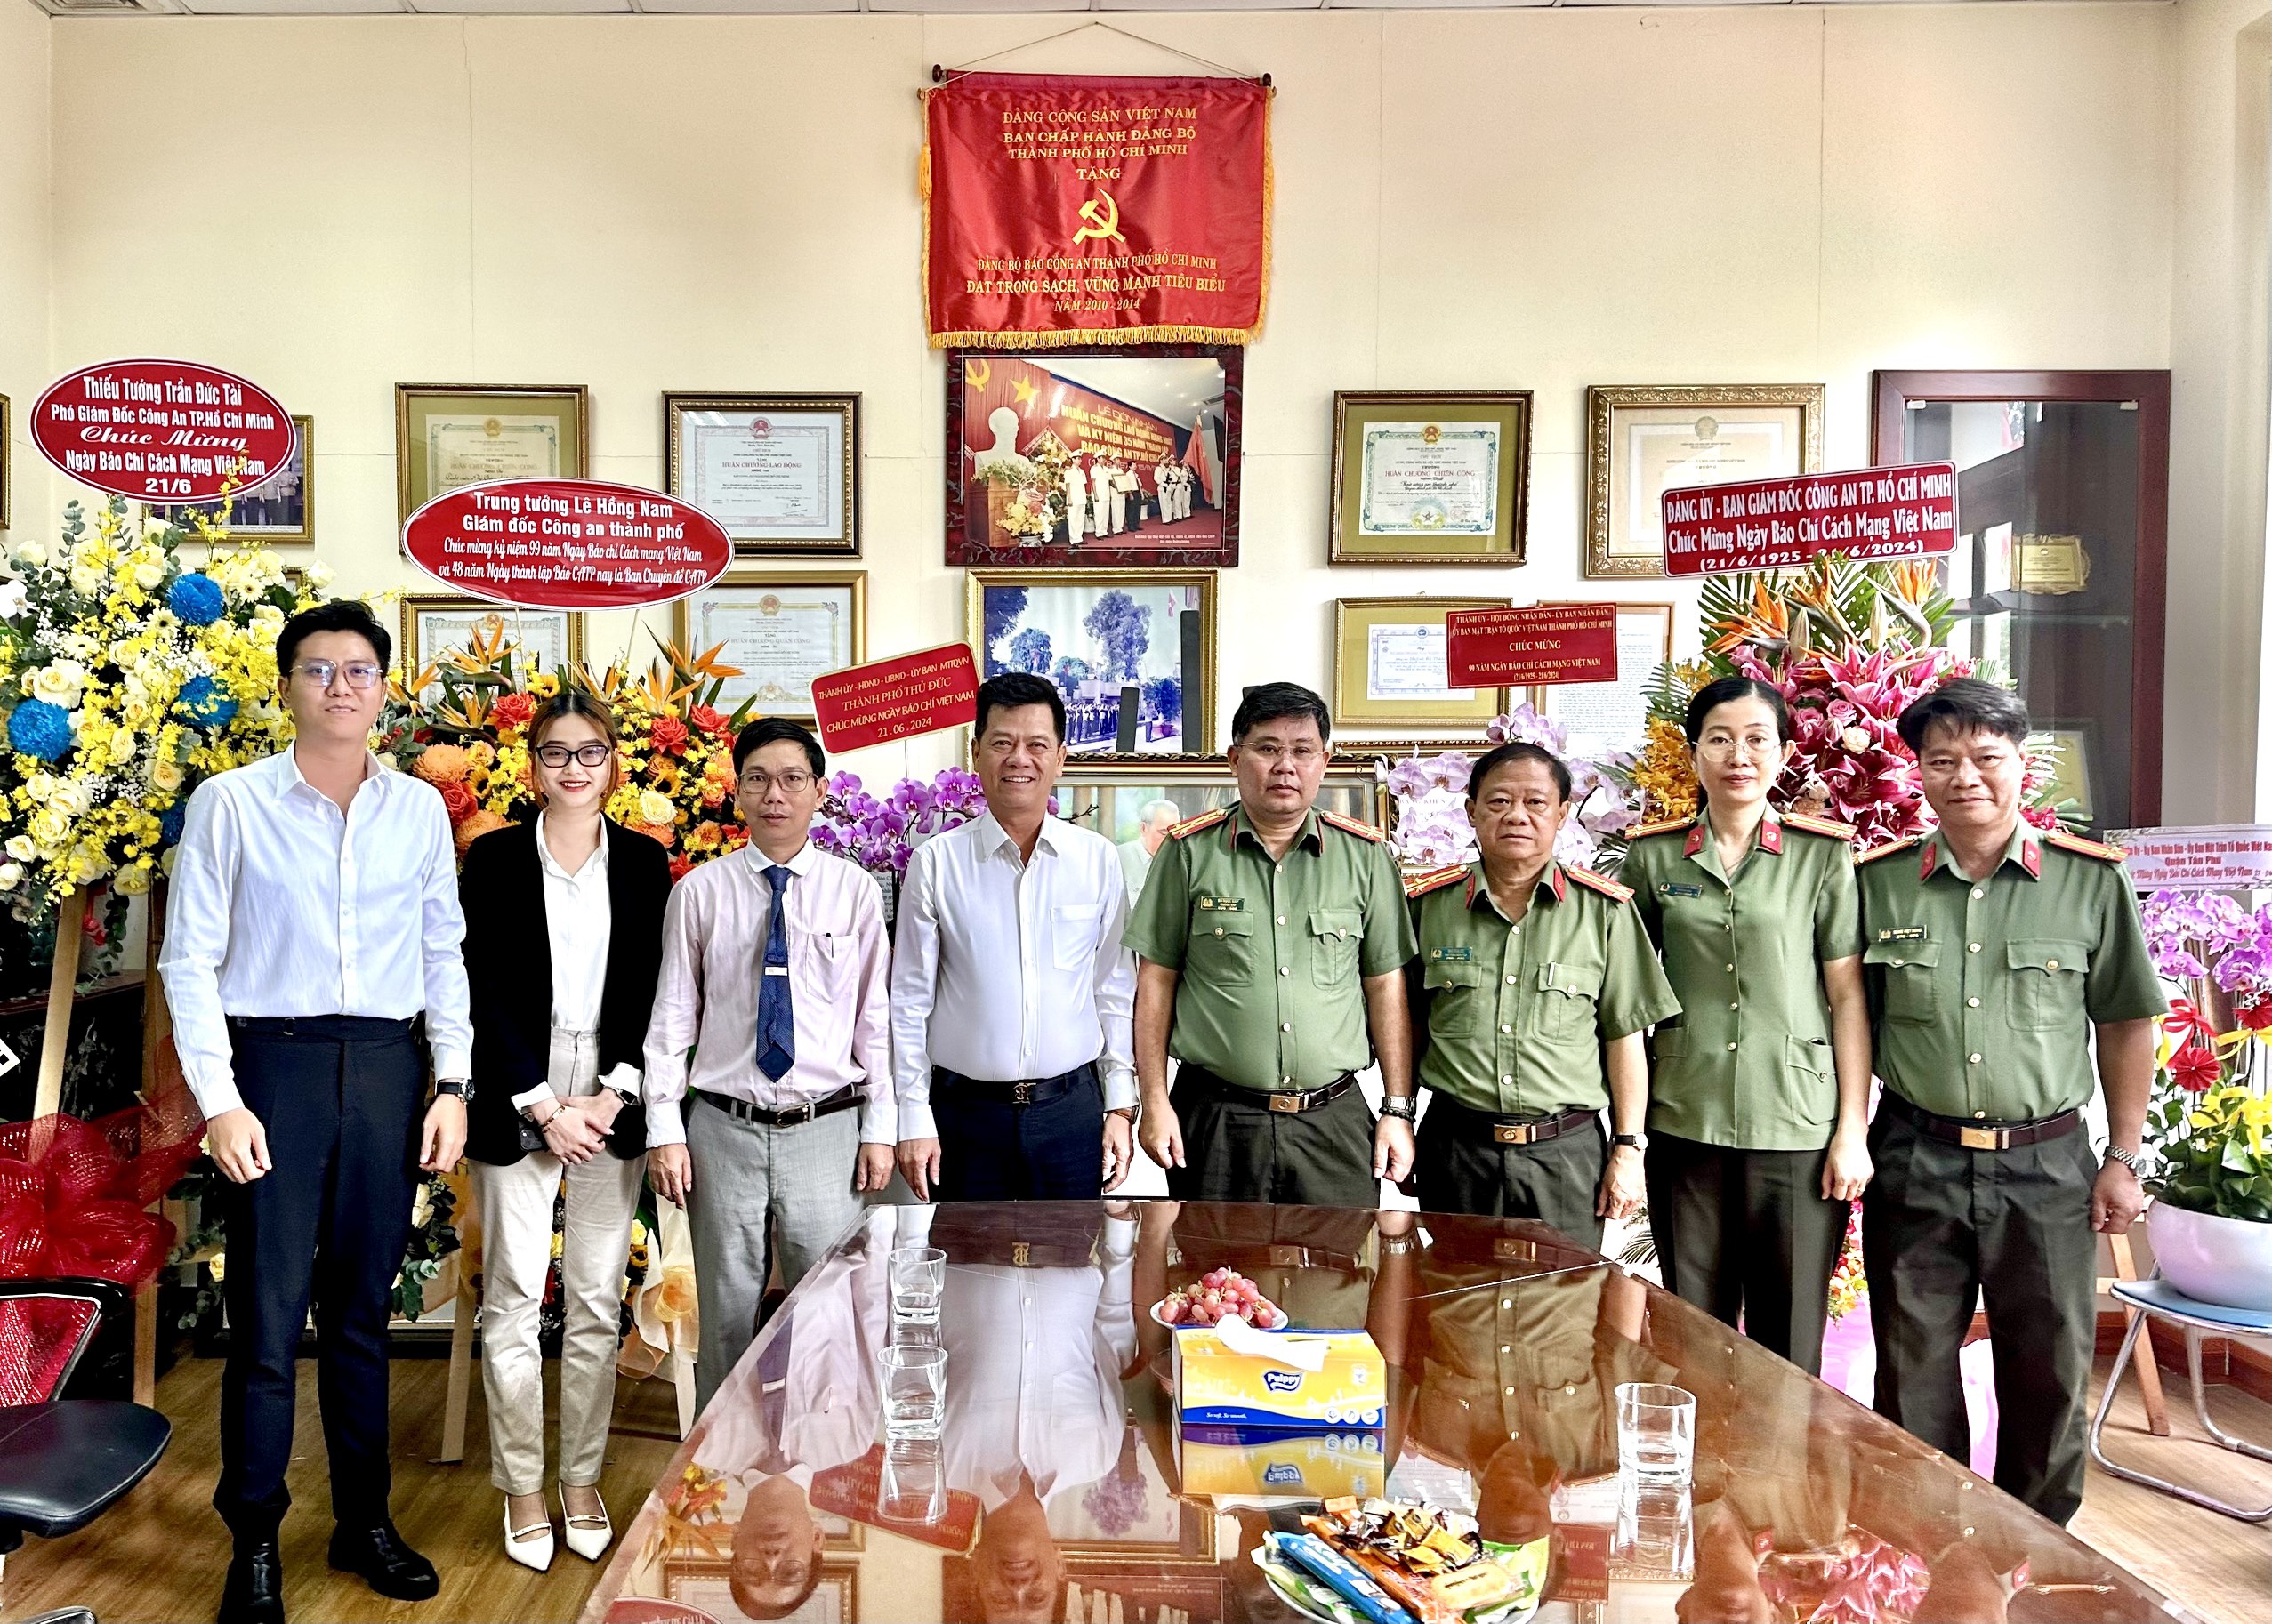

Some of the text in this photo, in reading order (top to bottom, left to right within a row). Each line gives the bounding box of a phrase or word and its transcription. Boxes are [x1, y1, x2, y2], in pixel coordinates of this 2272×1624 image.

[1003, 106, 1196, 125] ĐẢNG CỘNG SẢN VIỆT NAM
[1003, 125, 1196, 143] BAN CHẤP HÀNH ĐẢNG BỘ
[1009, 143, 1187, 159] THÀNH PHỐ HỒ CHÍ MINH
[1076, 165, 1122, 182] TẶNG
[978, 255, 1005, 271] ĐẢNG
[1008, 257, 1021, 273] BỘ
[1024, 255, 1044, 270] BÁO
[1076, 257, 1091, 269] AN
[1092, 254, 1129, 269] THÀNH
[1132, 248, 1152, 267] PHỐ
[1154, 248, 1169, 265] HỒ
[1171, 252, 1189, 266] CHÍ
[1191, 256, 1217, 269] MINH
[996, 280, 1038, 293] TRONG
[1084, 276, 1120, 292] VỮNG
[1164, 272, 1193, 289] TIÊU
[1196, 272, 1226, 293] BIỂU
[1054, 297, 1140, 312] NĂM 2010 2014
[83, 373, 242, 406] Thiếu Tướng Trần Đức Tài
[51, 403, 275, 430] Phó Giám Đốc Công An TP.Hồ Chí Minh
[80, 425, 249, 452] Chúc Mừng
[65, 449, 97, 473] Ngày
[99, 449, 122, 471] Báo
[125, 450, 145, 472] Chí
[147, 452, 178, 474] Cách
[180, 454, 212, 478] Mạng
[239, 455, 265, 477] Nam
[145, 478, 192, 494] 21/6
[1667, 470, 1952, 524] ĐẢNG ỦY BAN GIÁM ĐỐC CÔNG AN TP. HỒ CHÍ MINH
[473, 491, 673, 519] Trung tướng Lê Hồng Nam
[463, 514, 685, 543] Giám đốc Công an thành phố
[1668, 529, 1697, 554] Chúc
[1736, 523, 1768, 552] Ngày
[1770, 519, 1795, 545] Báo
[1798, 517, 1819, 542] Chí
[1821, 512, 1853, 540] Cách
[1855, 511, 1890, 542] Mạng
[1892, 507, 1919, 539] Việt
[1922, 505, 1953, 532] Nam
[444, 536, 465, 553] Chúc
[506, 539, 528, 559] niệm
[529, 540, 541, 556] 99
[542, 541, 562, 557] năm
[562, 541, 587, 562] Ngày
[587, 543, 605, 559] Báo
[605, 543, 618, 559] chí
[619, 543, 640, 559] Cách
[641, 547, 665, 565] mạng
[665, 545, 681, 564] Việt
[682, 545, 703, 562] Nam
[1700, 550, 1801, 572] (21/6/1925
[439, 560, 708, 588] và 48 năm Ngày thành lập Báo CATP nay là Ban Chuyên đề CATP
[1509, 638, 1561, 652] CHÚC MỪNG
[818, 656, 969, 700] THÀNH ỦY HĐND UBND ỦY BAN MTTQVN
[842, 676, 952, 712] THÀNH PHỐ THỦ ĐỨC
[826, 719, 850, 733] CHÚC
[877, 706, 901, 721] NGÀY
[901, 703, 920, 716] BÁO
[920, 696, 935, 711] CHÍ
[936, 694, 955, 707] VIỆT
[954, 690, 975, 703] NAM
[877, 716, 931, 738] 21 06 2024
[1267, 1372, 1301, 1385] Pulppy
